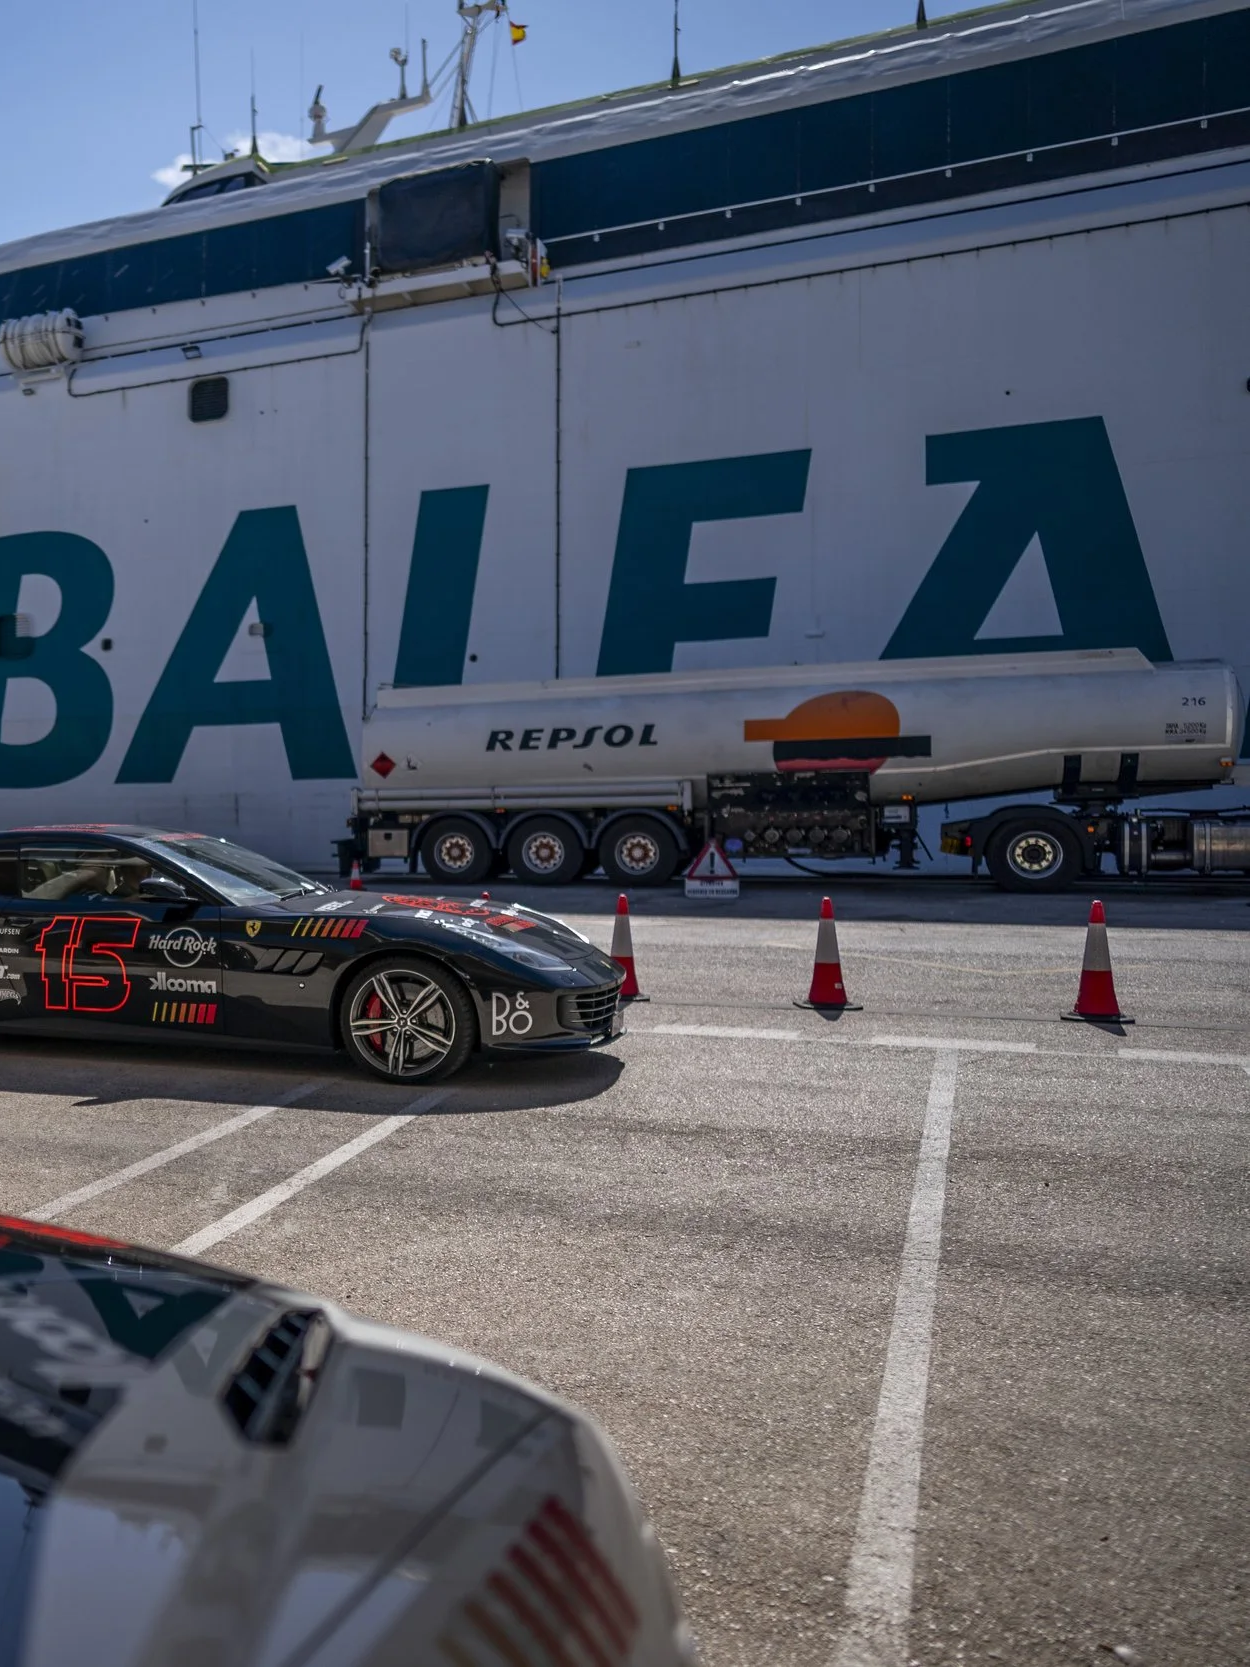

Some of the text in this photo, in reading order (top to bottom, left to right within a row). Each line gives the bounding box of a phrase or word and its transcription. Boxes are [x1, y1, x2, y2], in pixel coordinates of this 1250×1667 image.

[1181, 697, 1206, 706] 216
[485, 723, 658, 752] REPSOL
[148, 934, 217, 955] Hard Rock
[35, 915, 142, 1012] 15
[491, 990, 533, 1036] B&O
